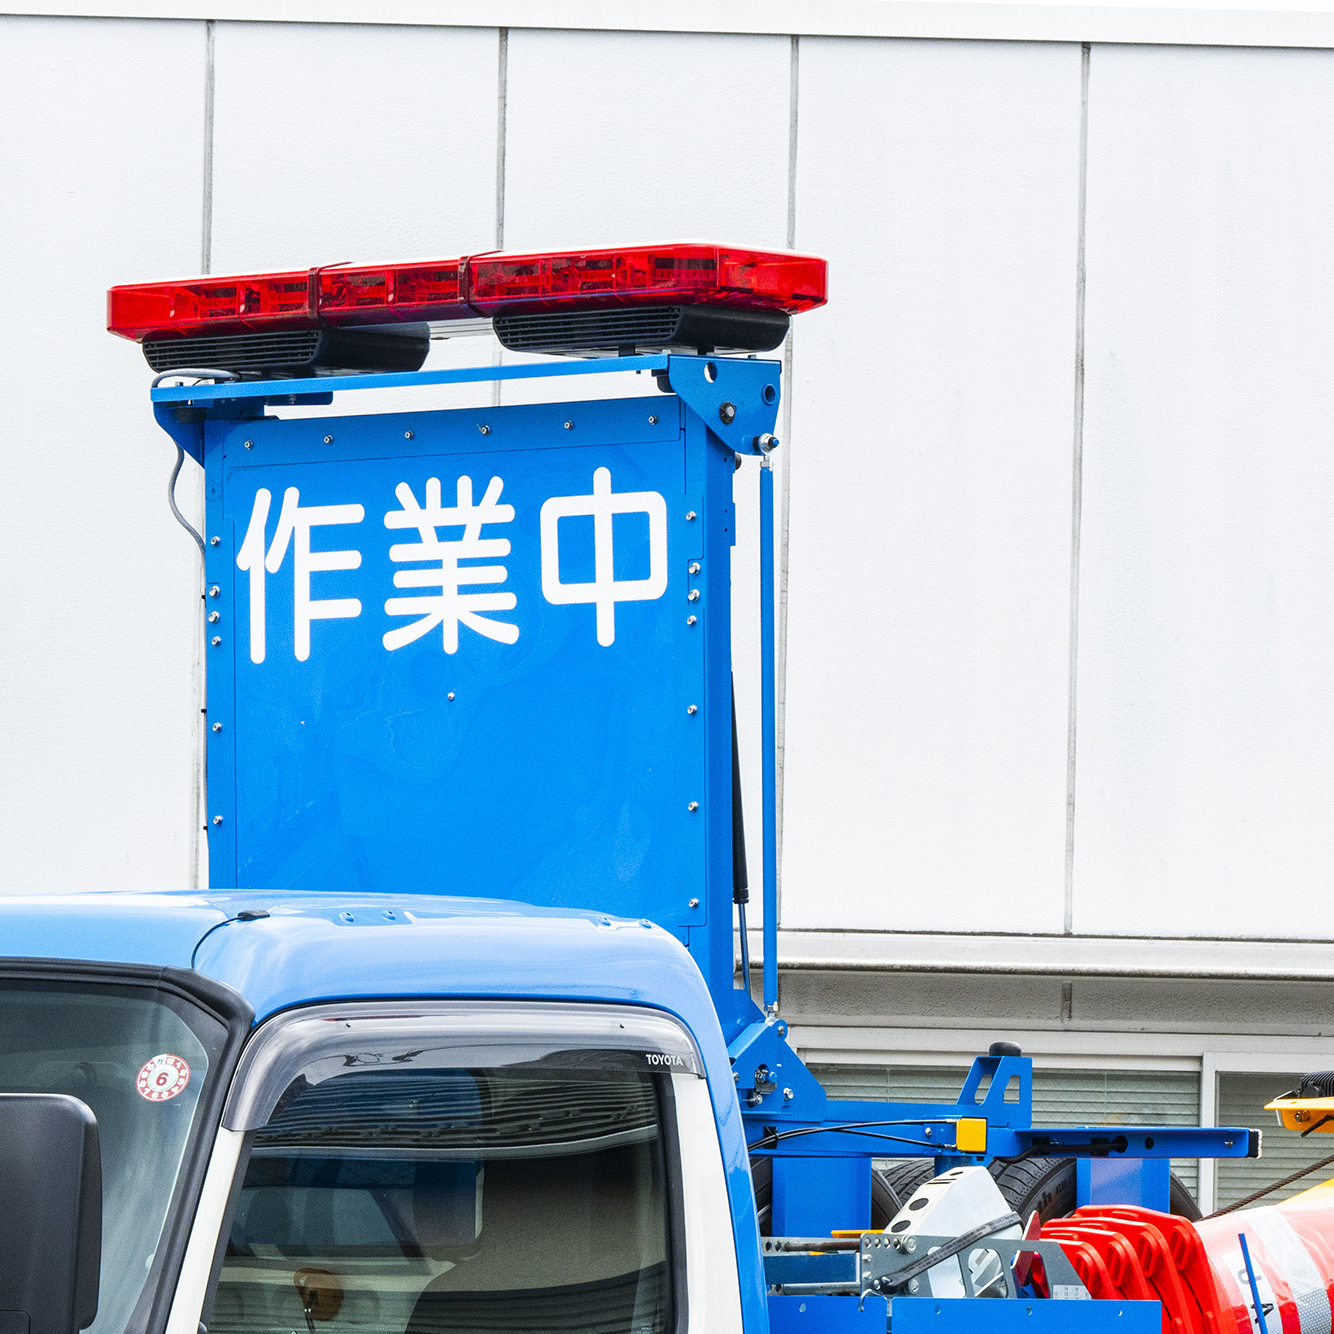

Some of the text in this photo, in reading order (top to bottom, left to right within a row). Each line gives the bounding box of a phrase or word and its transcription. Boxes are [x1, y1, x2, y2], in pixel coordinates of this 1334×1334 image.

[236, 466, 668, 664] 作業中
[645, 1053, 684, 1066] TOYOTA
[155, 1071, 169, 1087] 6
